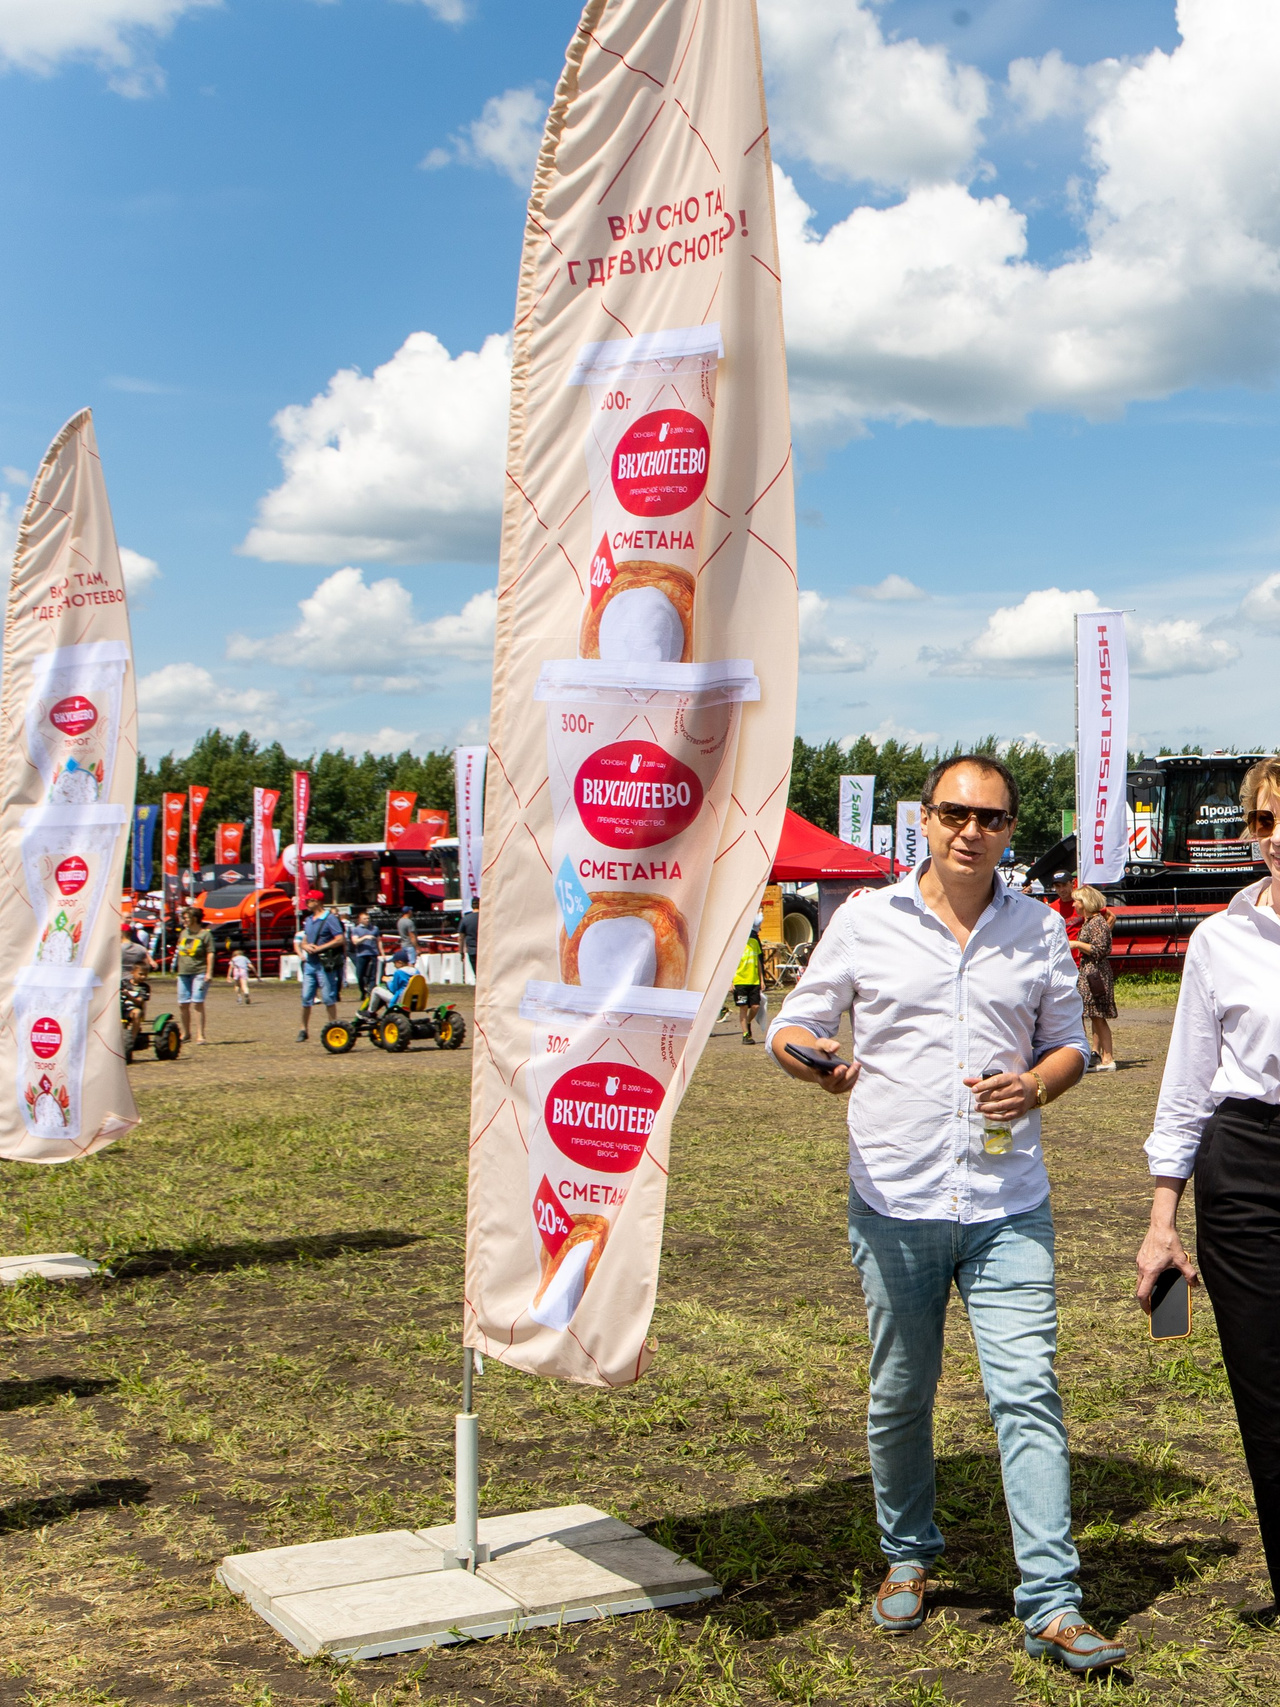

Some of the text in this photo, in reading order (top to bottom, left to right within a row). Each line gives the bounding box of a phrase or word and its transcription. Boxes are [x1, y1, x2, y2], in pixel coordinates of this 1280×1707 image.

[607, 183, 726, 241] ВКУСНО ТА
[617, 447, 706, 480] ВКУСНОТЕЕВО
[629, 486, 688, 496] ПРЕКРАСНОЕ ЧУВСТВО
[613, 530, 695, 550] СМЕТАНА
[591, 555, 612, 588] 20%
[32, 606, 54, 621] ГДЕ
[561, 713, 595, 733] 300г
[1094, 625, 1112, 865] ROSTSELMASH
[600, 758, 627, 766] ОСНОВАН
[582, 778, 691, 809] ВКУСНОТЕЕВО
[596, 816, 666, 827] ПРЕКРАСНОЕ ЧУВСТВО
[850, 794, 862, 848] SaMAS
[1200, 805, 1244, 818] Продан
[614, 827, 634, 835] ВКУСА
[905, 827, 917, 869] АЛМА
[579, 859, 682, 881] СМЕТАНА
[557, 879, 584, 915] 15%
[546, 1034, 571, 1055] 300г
[570, 1079, 600, 1088] ОСНОВАН
[627, 1084, 641, 1092] 2000
[552, 1097, 660, 1135] ВКУСНОТЕЕВ
[571, 1138, 641, 1153] ПРЕКРАСНОЕ ЧУВСТВО
[597, 1150, 619, 1158] ВКУСА
[558, 1180, 629, 1206] СМЕТАН
[537, 1198, 568, 1235] 20%
